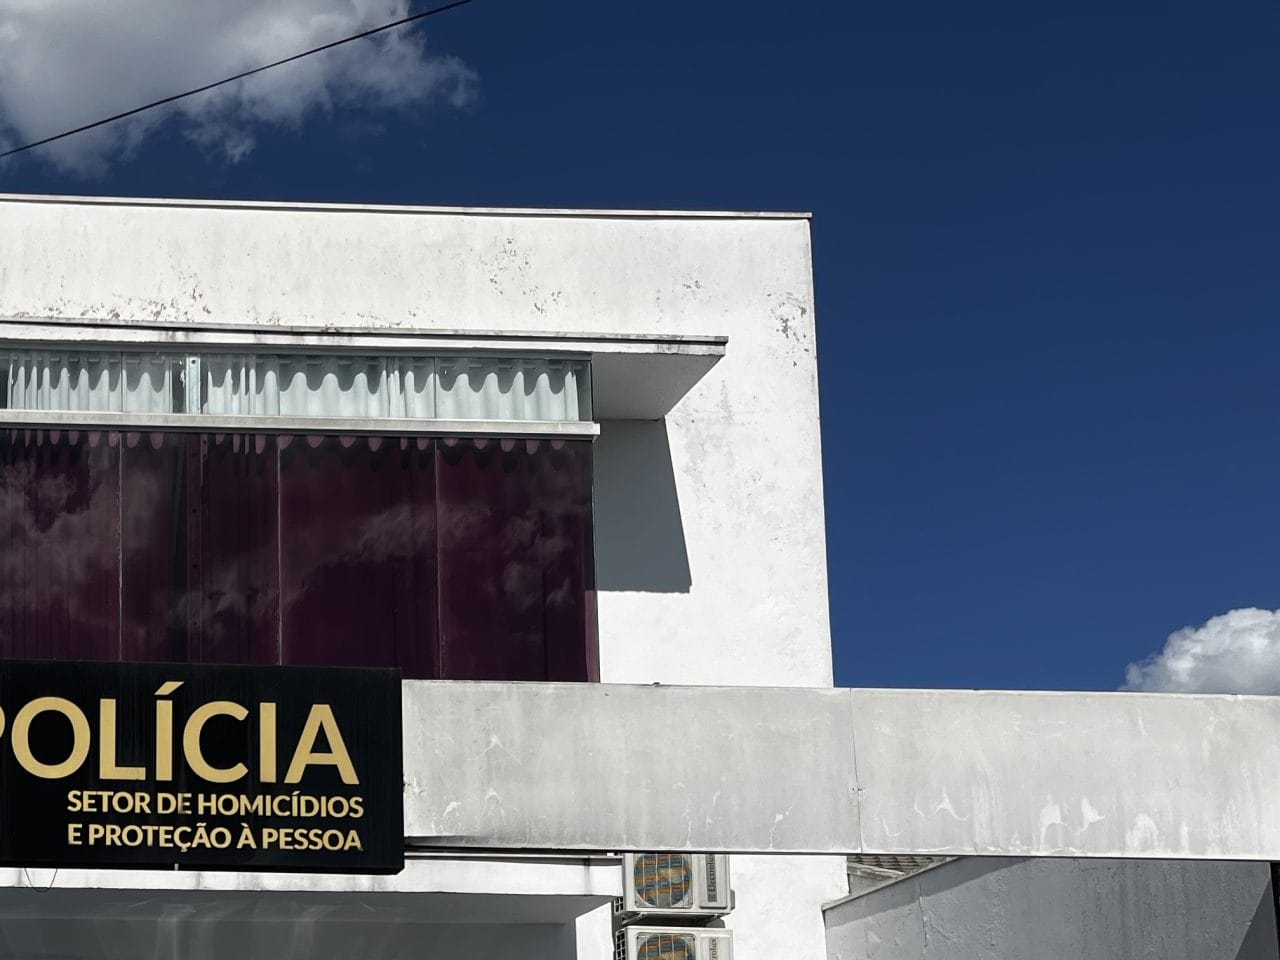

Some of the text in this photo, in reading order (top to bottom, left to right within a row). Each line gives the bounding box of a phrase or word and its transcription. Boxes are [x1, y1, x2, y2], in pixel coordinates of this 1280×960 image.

[67, 790, 364, 818] SETOR DE HOMICÍDIOS
[68, 822, 363, 853] E PROTEÇÃO À PESSOA
